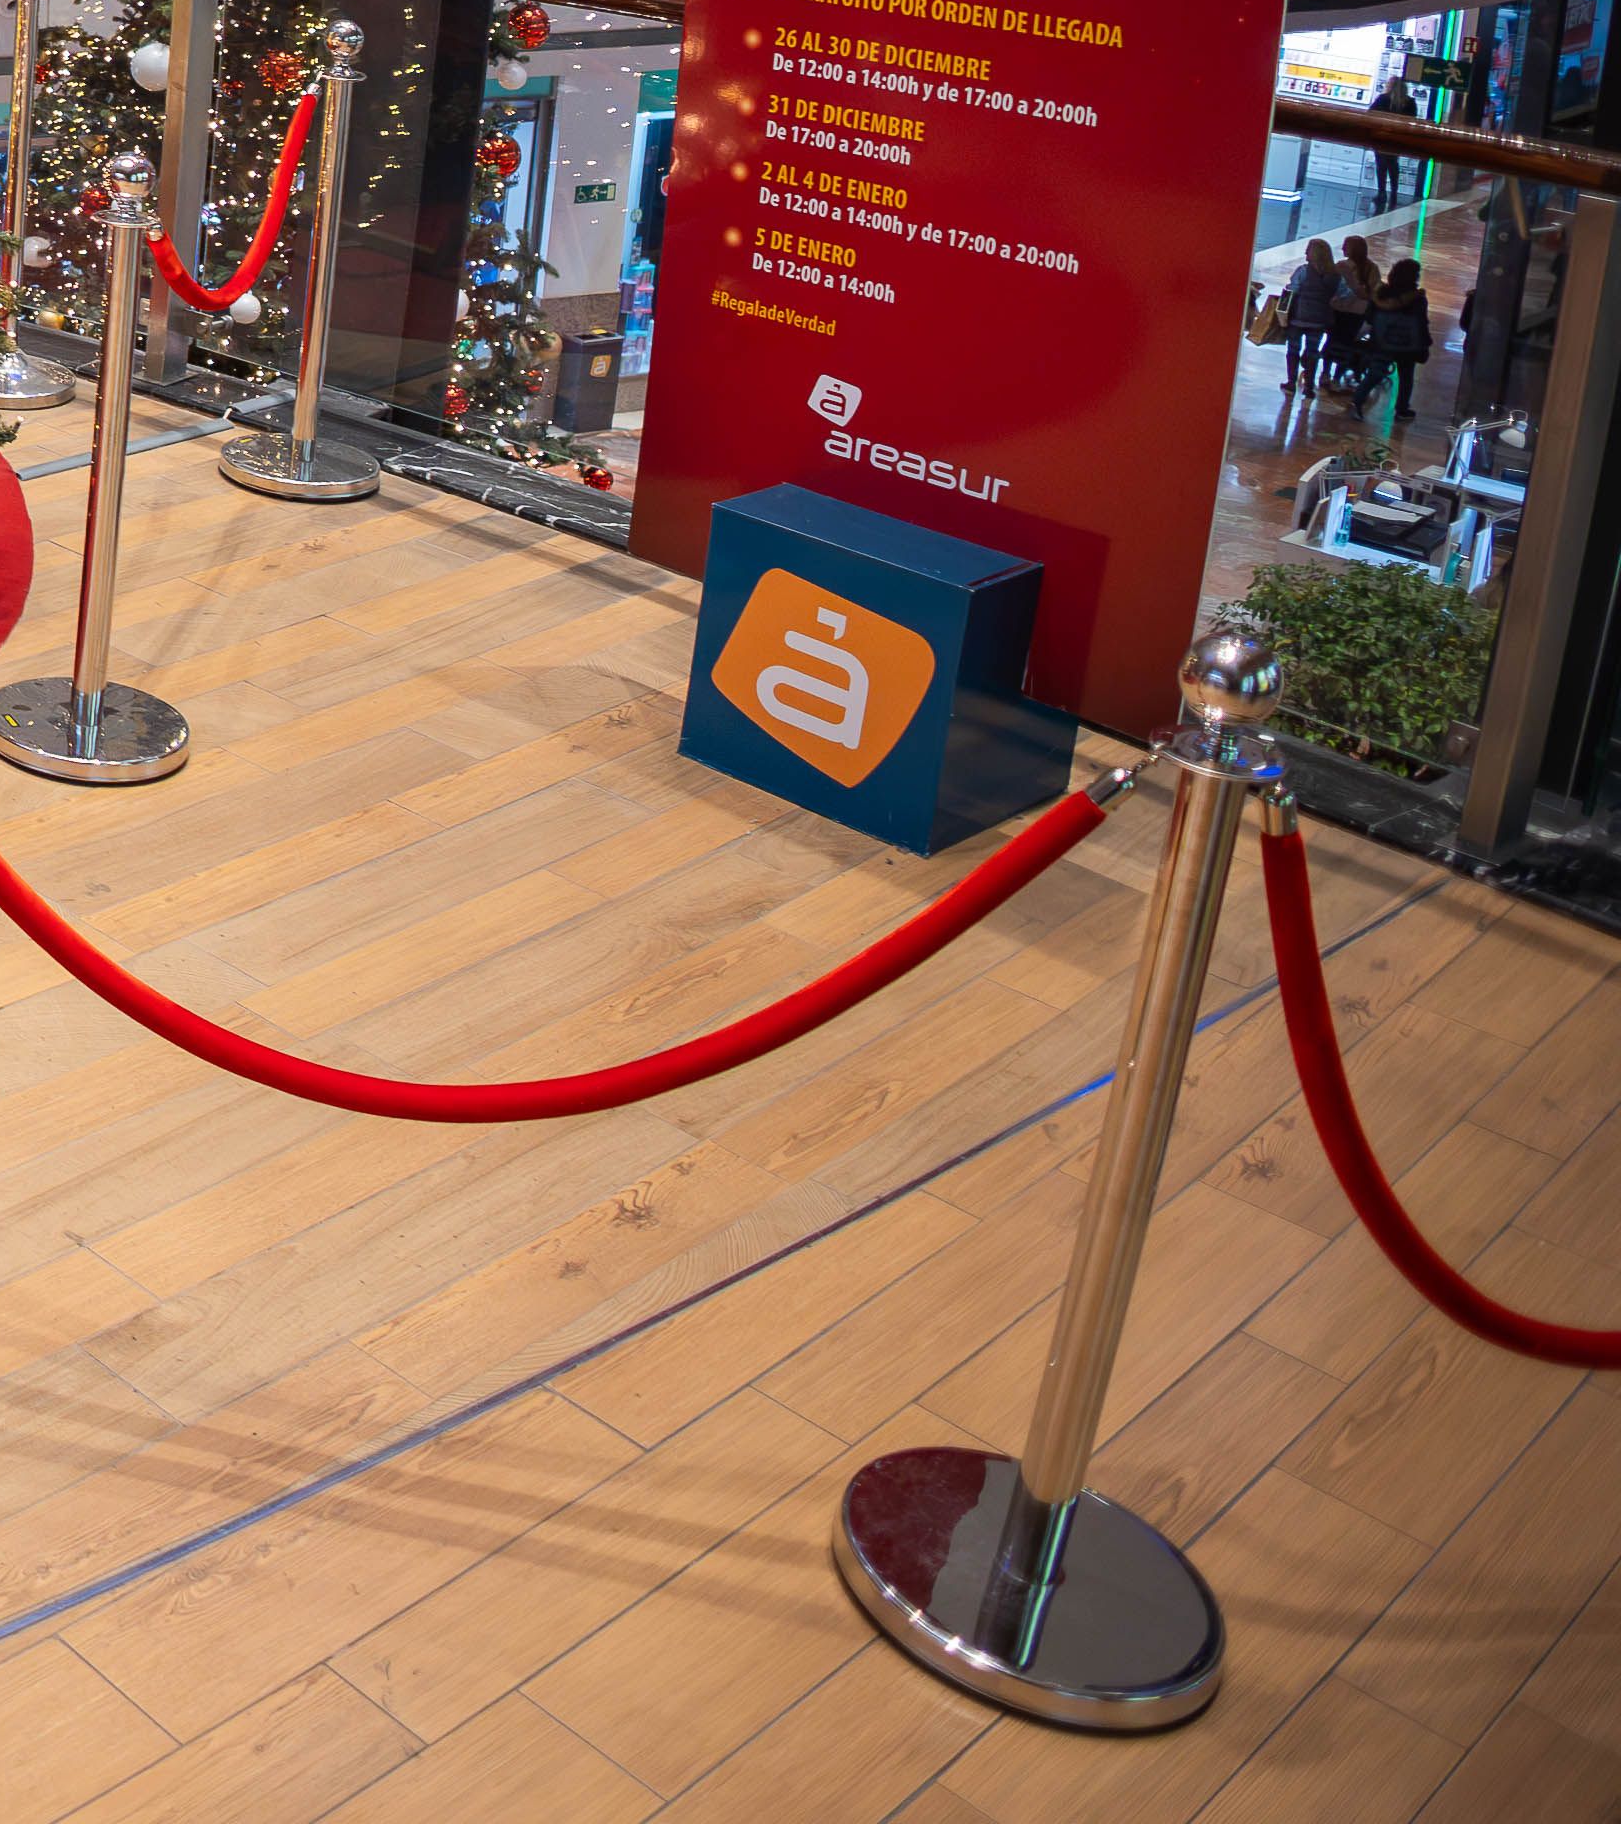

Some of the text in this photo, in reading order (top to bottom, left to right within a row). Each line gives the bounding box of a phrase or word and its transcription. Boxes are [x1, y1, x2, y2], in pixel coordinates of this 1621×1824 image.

[1002, 9, 1027, 34] DE
[1033, 13, 1123, 49] LLEGADA
[774, 27, 991, 81] 26 AL 30 DE DICIEMBRE
[773, 53, 1098, 128] De 12:00 a 14:00h y de 17:00 a 20:00h
[768, 94, 926, 142] 31 DE DICIEMBRE
[765, 120, 911, 166] De 17:00 a 20:00h
[762, 161, 908, 209] 2 AL 4 DE ENERO
[755, 228, 857, 268] 5 DE ENERO
[759, 186, 1080, 274] De 12:00 a 14:00h y de 17:00 a 20:00h
[752, 252, 895, 304] De 12:00 a 14:00h
[711, 290, 836, 336] #RegaladeVerdad
[824, 430, 1010, 503] areasur
